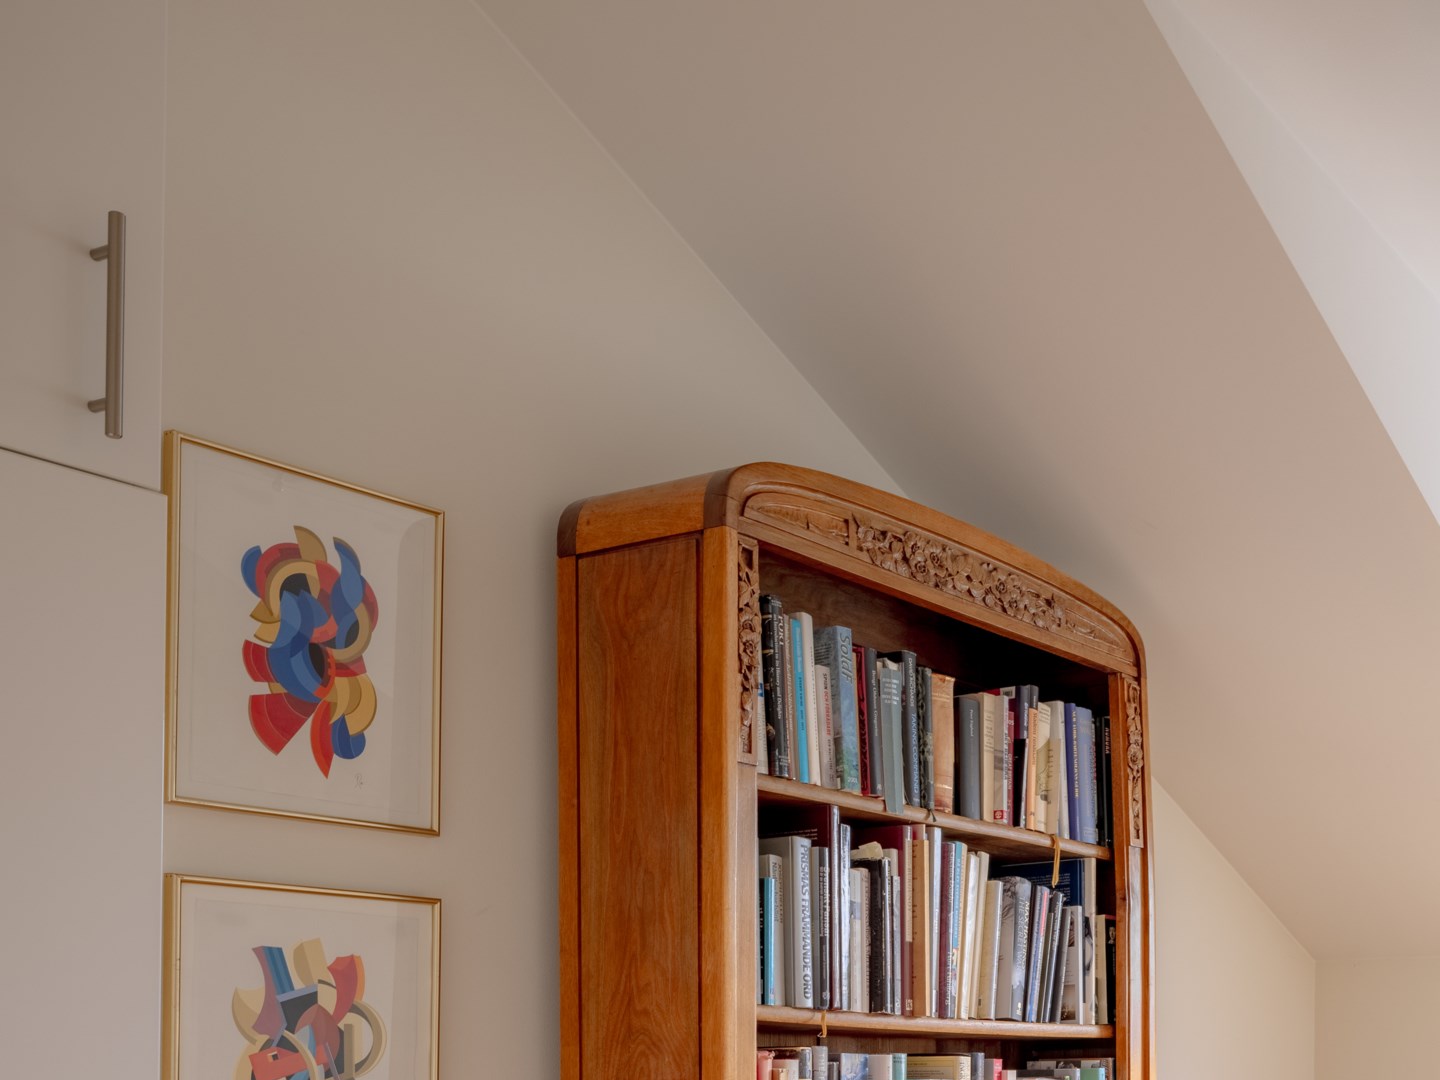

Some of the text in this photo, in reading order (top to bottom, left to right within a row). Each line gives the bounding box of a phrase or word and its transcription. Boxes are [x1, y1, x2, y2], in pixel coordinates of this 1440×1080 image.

[838, 632, 854, 684] SoldF
[912, 747, 920, 794] COMMAND
[800, 845, 812, 999] PRISMAS FRÄMMANDE ORD
[1016, 896, 1026, 971] THE SECRET WAR
[1021, 924, 1029, 970] HASTINGS
